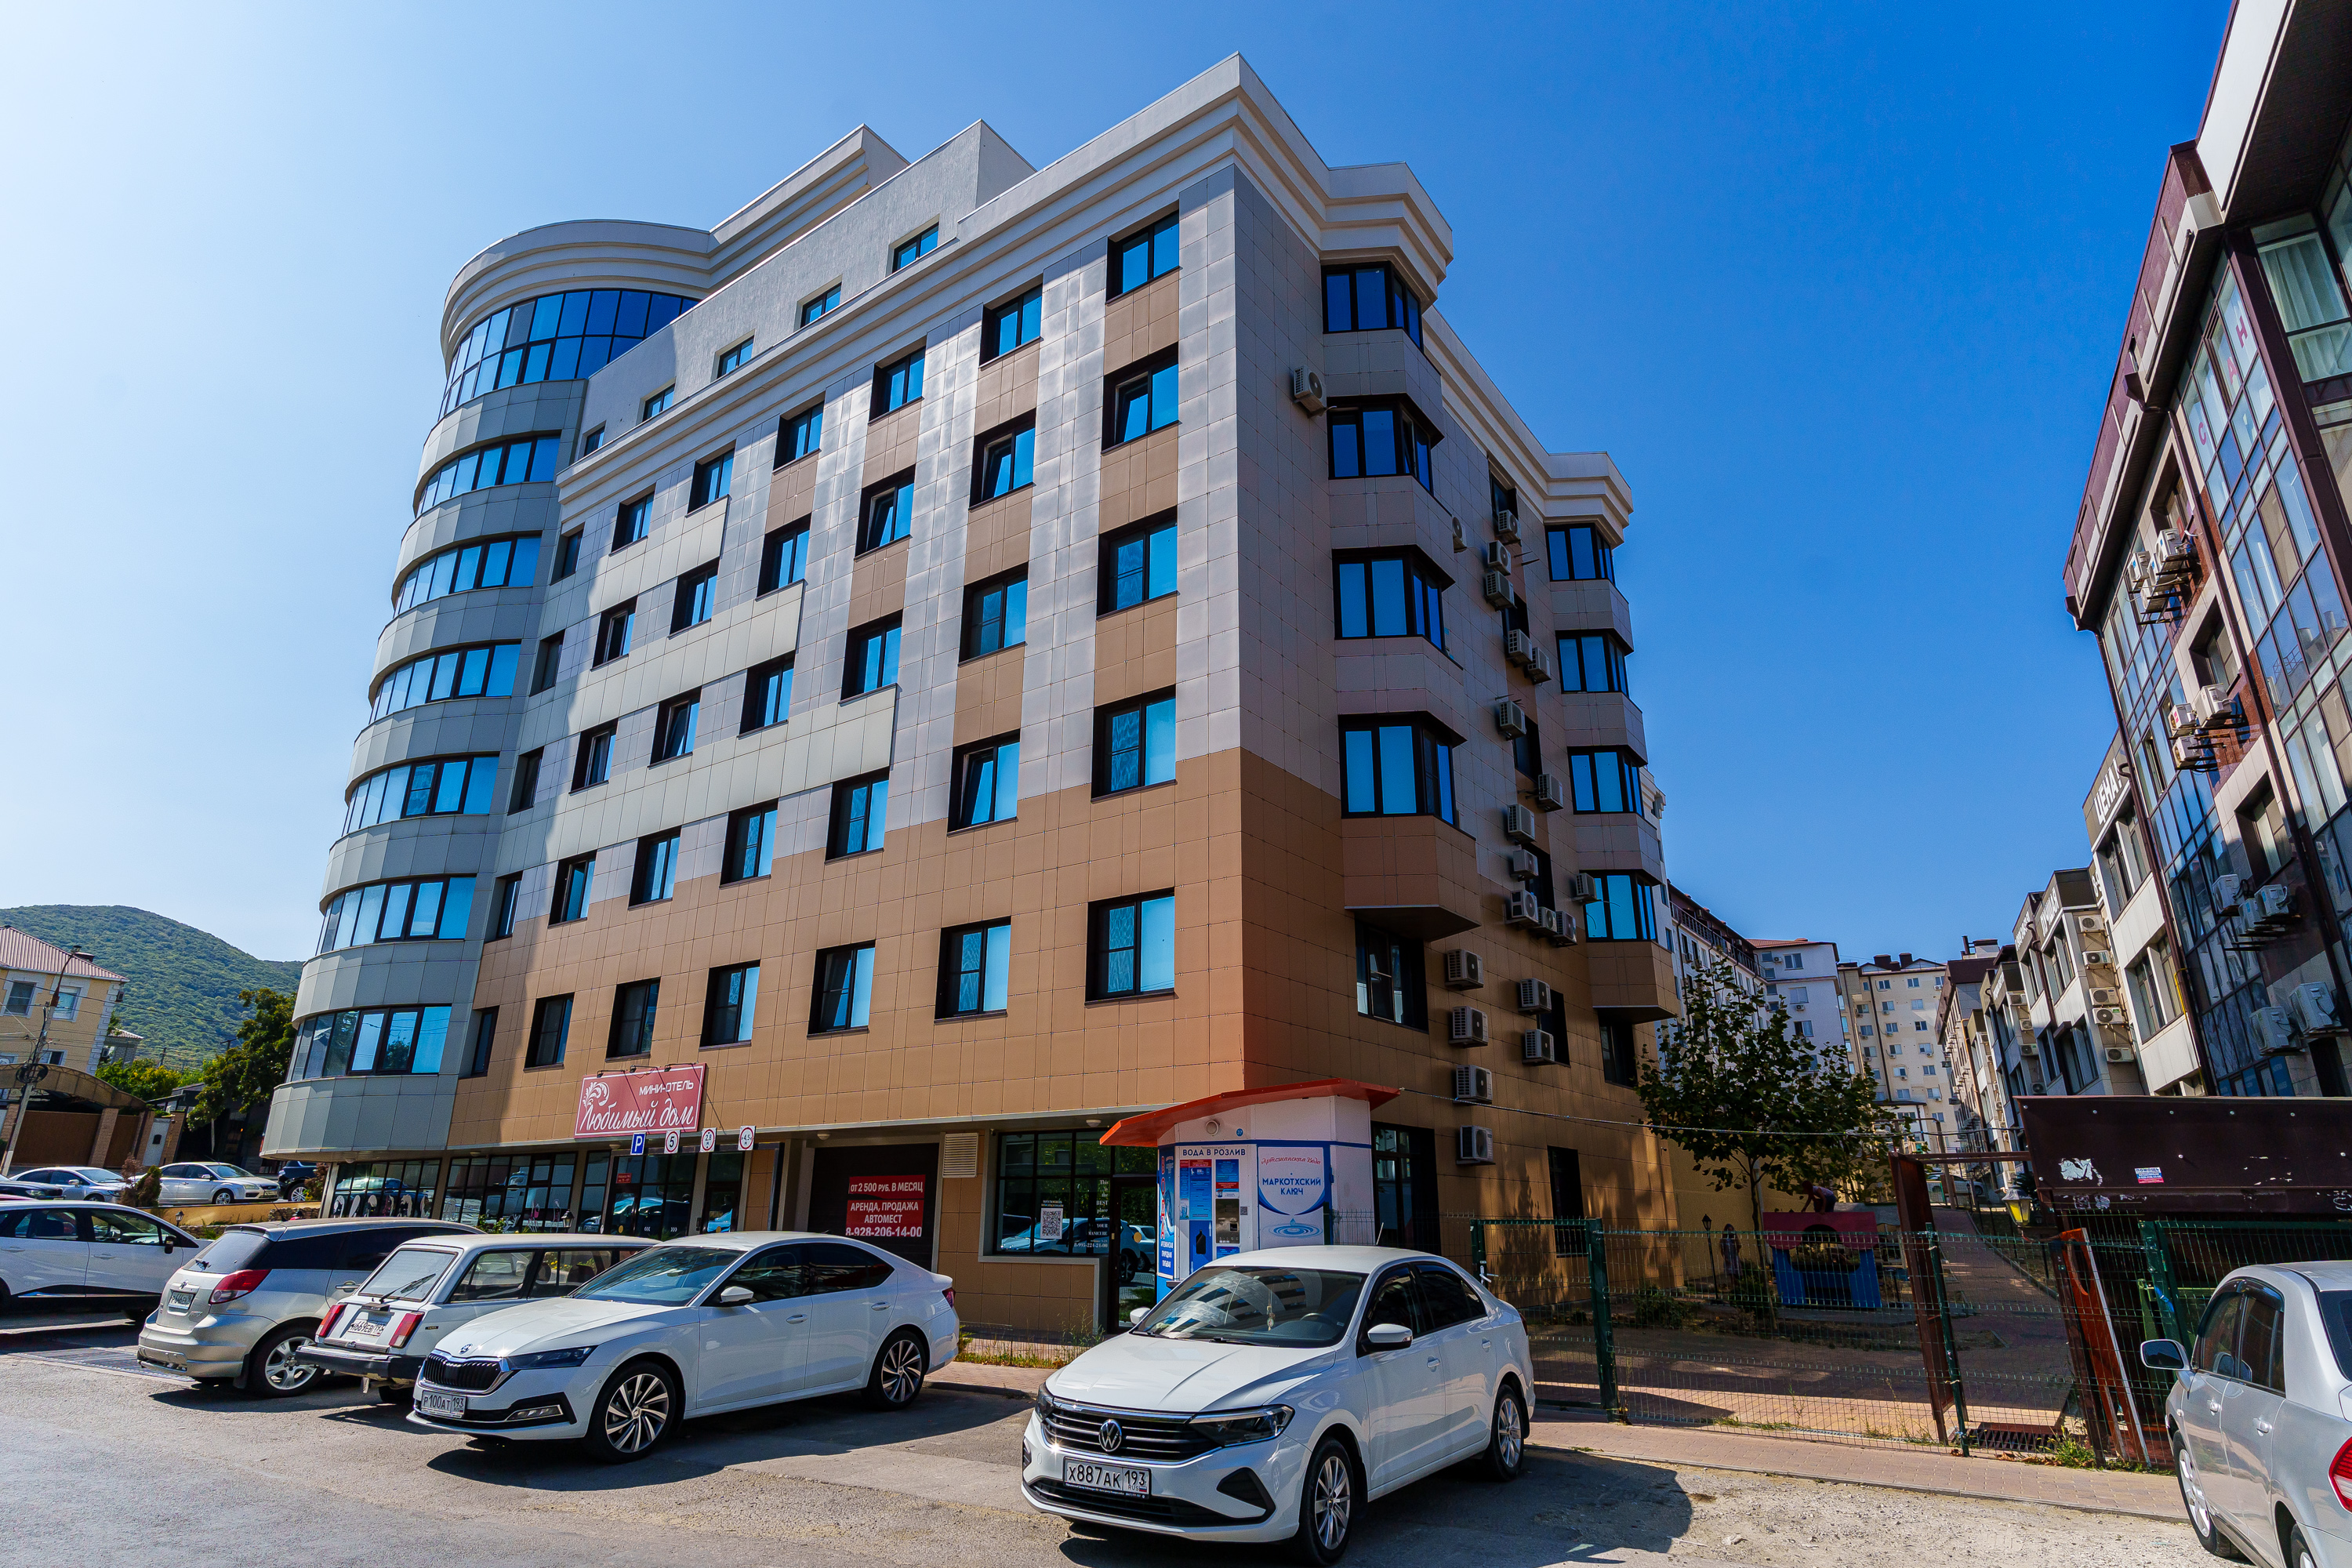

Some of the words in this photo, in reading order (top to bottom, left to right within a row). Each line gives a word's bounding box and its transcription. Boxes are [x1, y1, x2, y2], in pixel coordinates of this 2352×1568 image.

[2094, 757, 2122, 825] ЦЕНА!
[639, 1080, 694, 1096] МИНИ-ОТЕЛЬ
[579, 1100, 659, 1131] Любимый
[659, 1098, 694, 1127] дом
[670, 1137, 674, 1147] 5
[858, 1182, 862, 1192] 2
[863, 1182, 877, 1192] 500
[891, 1182, 896, 1192] В
[898, 1181, 923, 1192] МЕСЯЦ
[1262, 1177, 1321, 1185] МАРКОТХСКИЙ
[851, 1202, 880, 1213] АРЕНДА,
[881, 1202, 919, 1213] ПРОДАЖА
[864, 1214, 902, 1223] АВТОМЕСТ
[845, 1226, 922, 1237] 8-928-206-14-00
[452, 1397, 463, 1408] 193
[1124, 1470, 1145, 1486] 193
